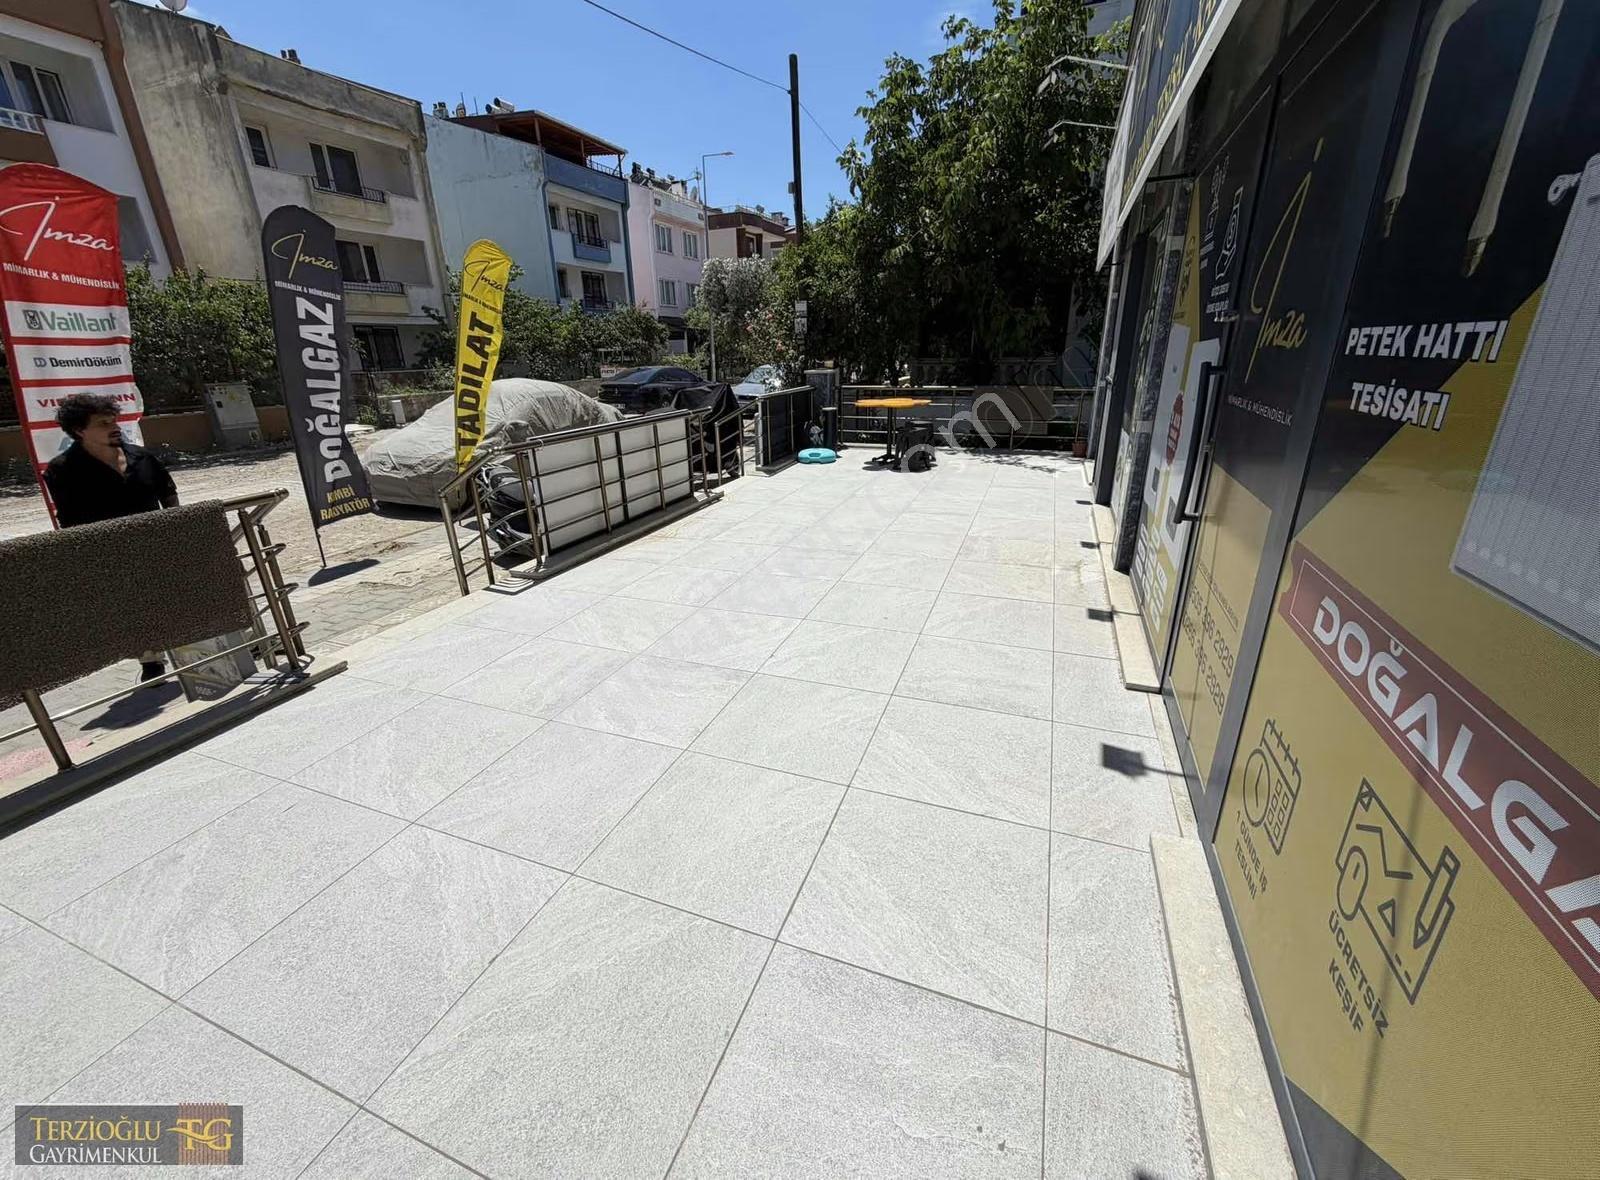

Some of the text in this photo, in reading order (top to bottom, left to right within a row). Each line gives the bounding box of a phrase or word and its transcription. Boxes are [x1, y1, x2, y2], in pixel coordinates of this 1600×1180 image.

[4, 262, 120, 290] MİMARLIK & MÜHENDİSLİK
[41, 311, 117, 333] Vaillant
[1345, 320, 1508, 361] PETEK HATTI
[50, 354, 122, 369] DemirDöküm
[296, 294, 352, 484] DOĞALGAZ
[1350, 378, 1450, 430] TESİSATI
[1213, 629, 1234, 678] 2929
[1329, 910, 1389, 1038] ÜCRETSİZ
[1329, 958, 1364, 1033] KEŞİF
